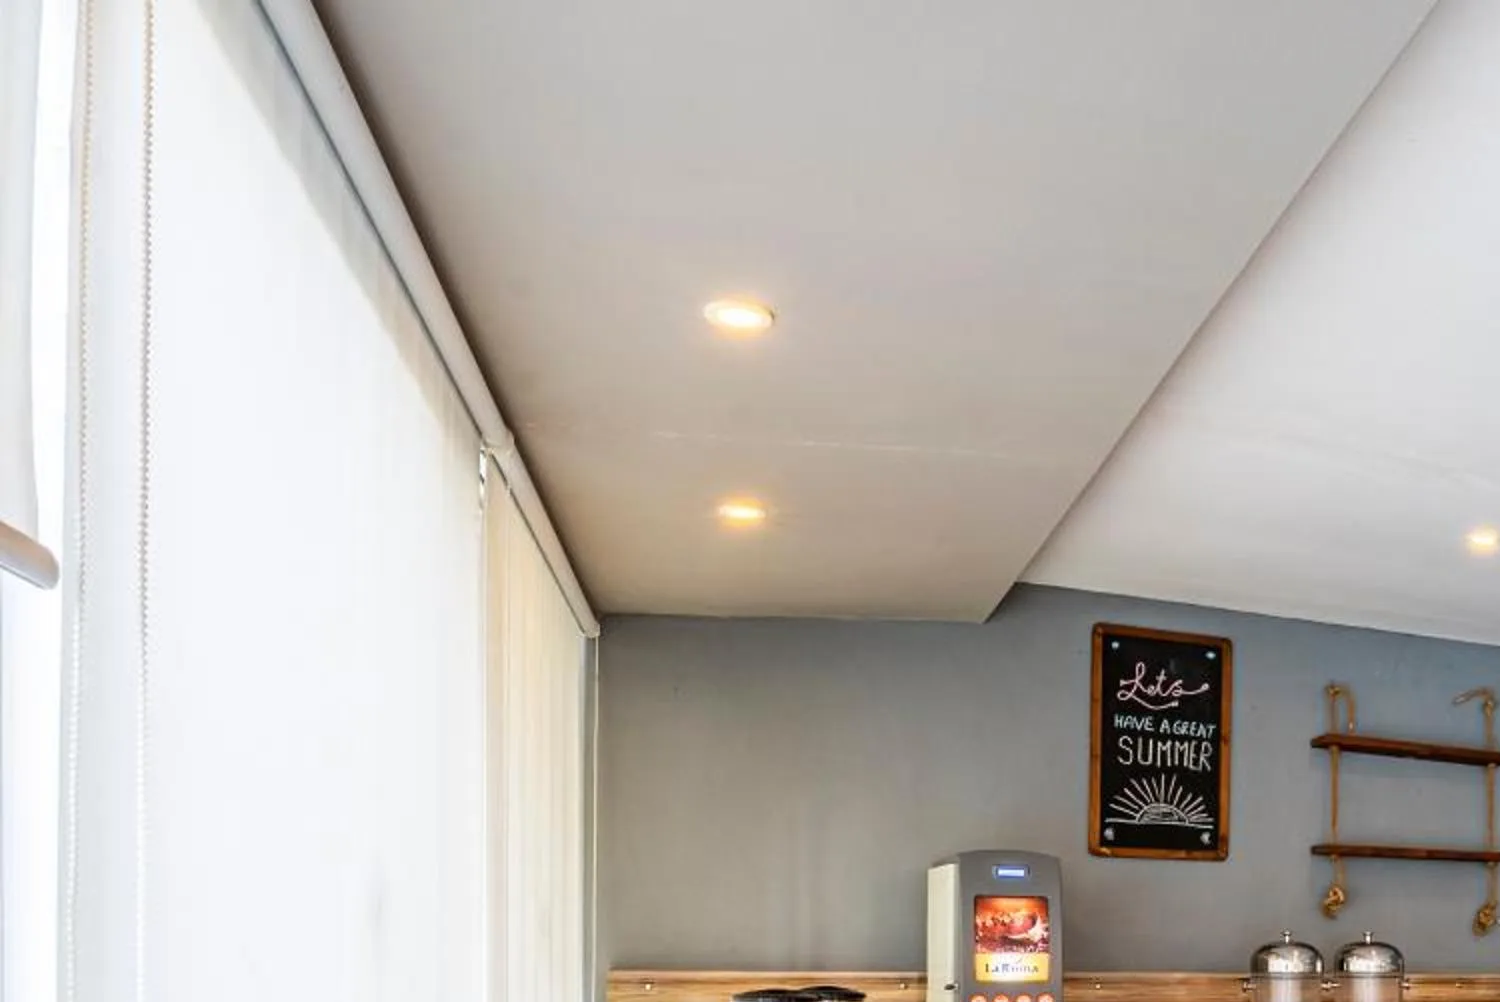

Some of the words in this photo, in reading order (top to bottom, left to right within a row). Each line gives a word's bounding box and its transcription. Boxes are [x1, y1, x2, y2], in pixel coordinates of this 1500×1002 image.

[1114, 713, 1155, 732] HAVE
[1160, 718, 1170, 734] A
[1172, 719, 1216, 738] GREAT
[1117, 735, 1212, 772] SUMMER
